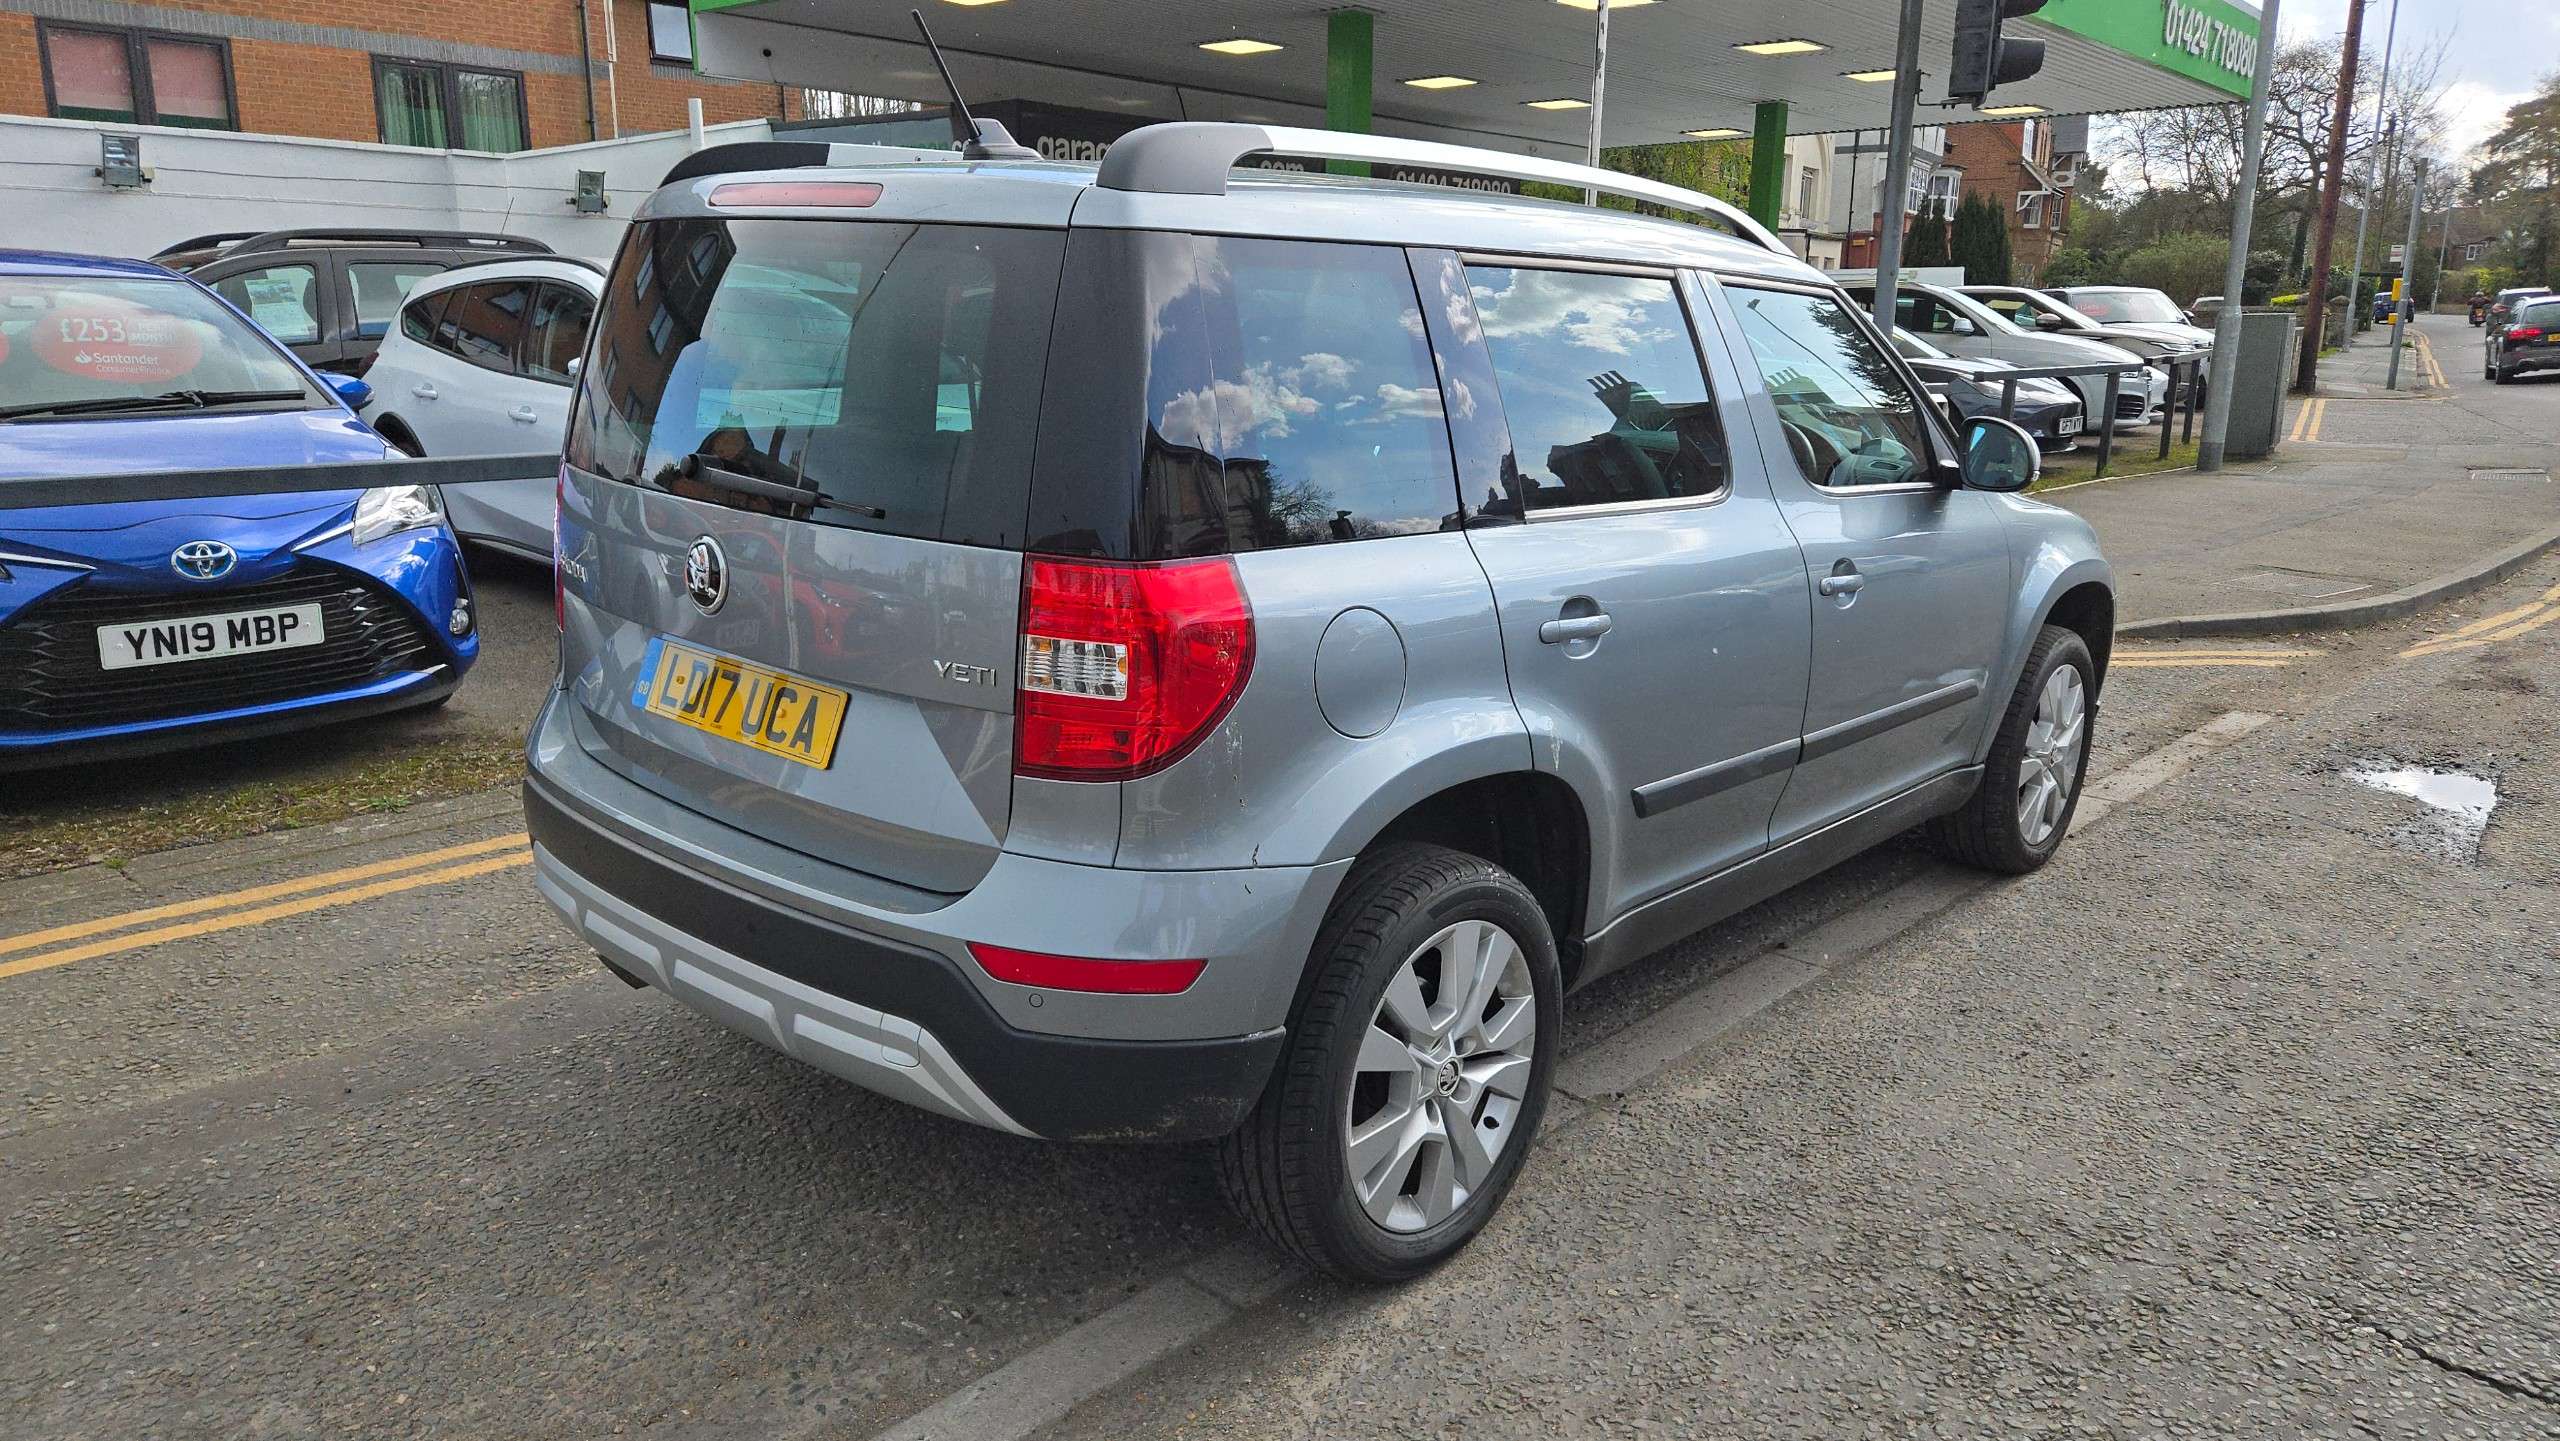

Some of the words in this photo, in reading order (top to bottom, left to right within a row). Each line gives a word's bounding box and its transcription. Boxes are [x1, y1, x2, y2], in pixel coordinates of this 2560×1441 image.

[2165, 0, 2210, 57] 01424
[2211, 20, 2258, 78] 718080
[60, 318, 126, 343] £253
[94, 351, 159, 365] Santander
[124, 622, 215, 660] YN19
[226, 612, 299, 648] MBP
[933, 659, 997, 687] YETI
[660, 653, 741, 723] LD17
[741, 678, 819, 753] UCA
